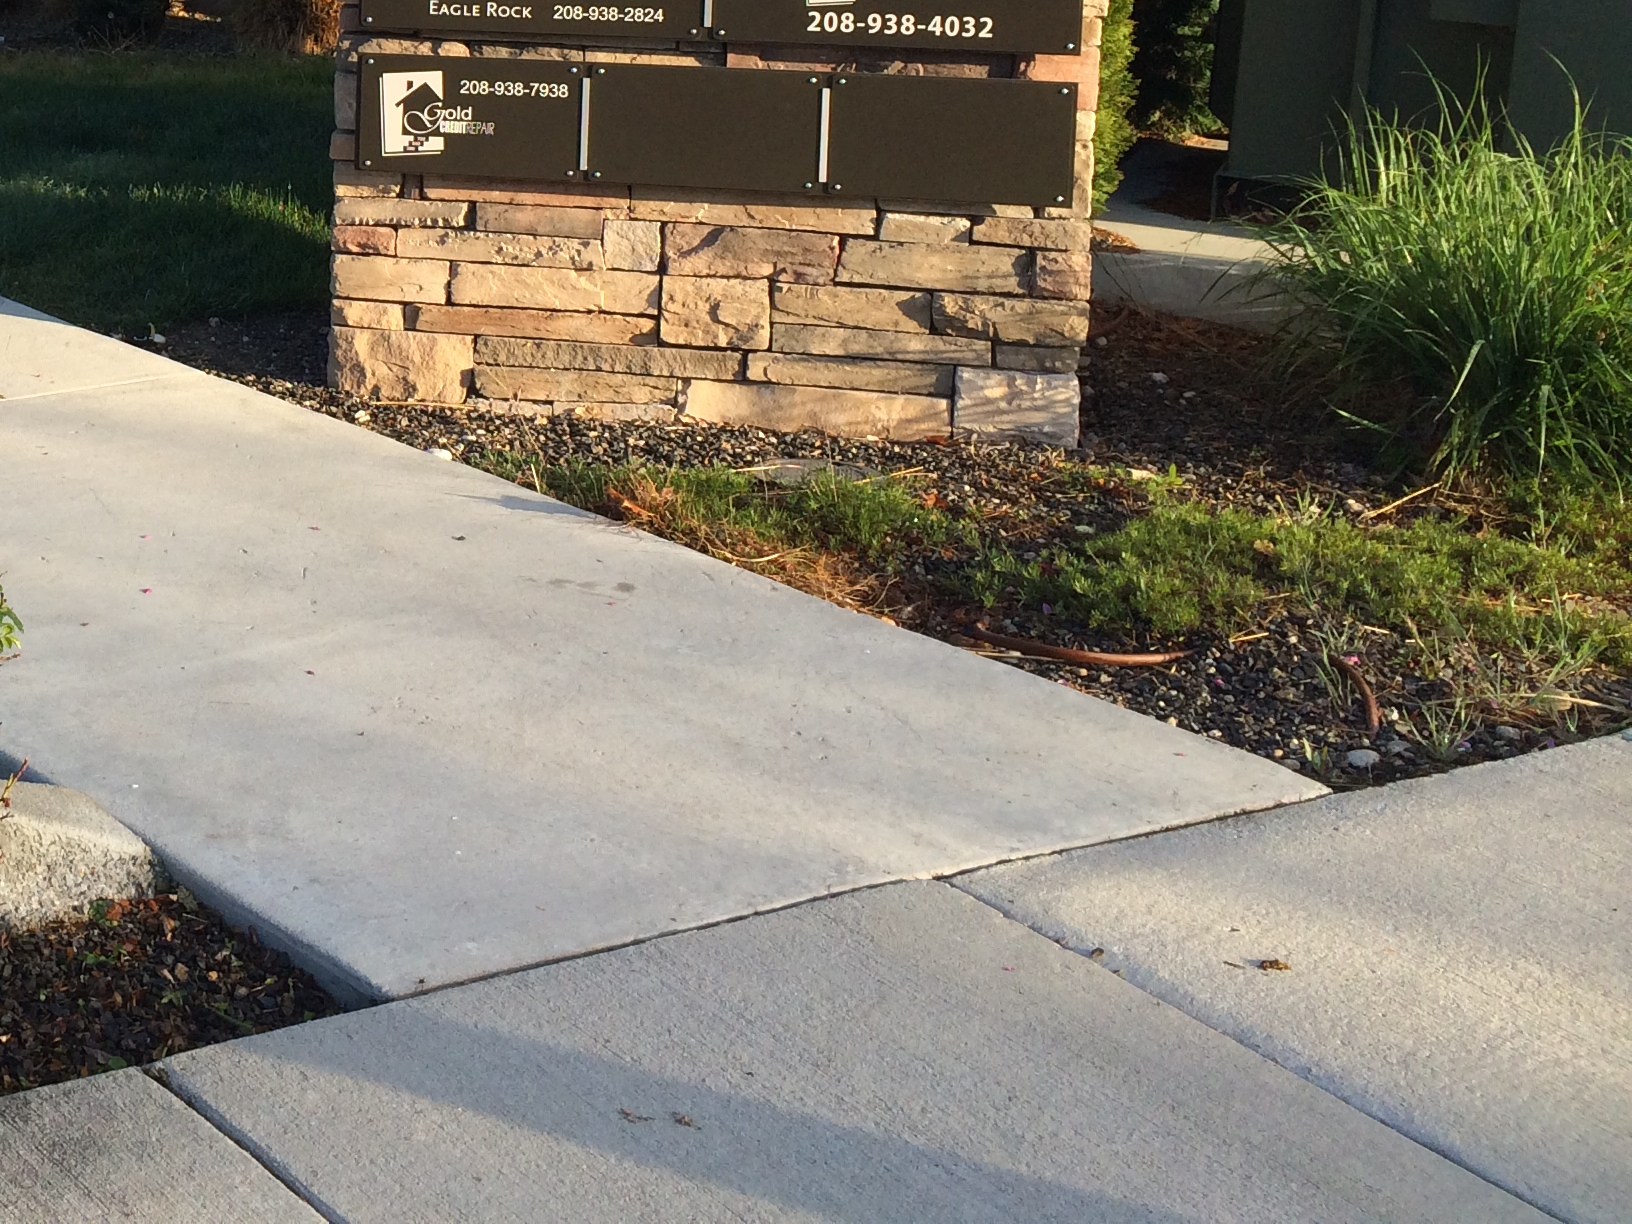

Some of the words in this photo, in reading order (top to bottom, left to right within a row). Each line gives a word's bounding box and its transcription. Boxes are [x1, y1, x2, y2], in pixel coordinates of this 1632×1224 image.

[429, 0, 480, 17] EAGLE
[486, 1, 532, 19] ROCK
[553, 4, 664, 23] 208-938-2824
[806, 11, 994, 38] 208-938-4032
[459, 79, 569, 99] 208-938-7938
[404, 102, 473, 134] Gold
